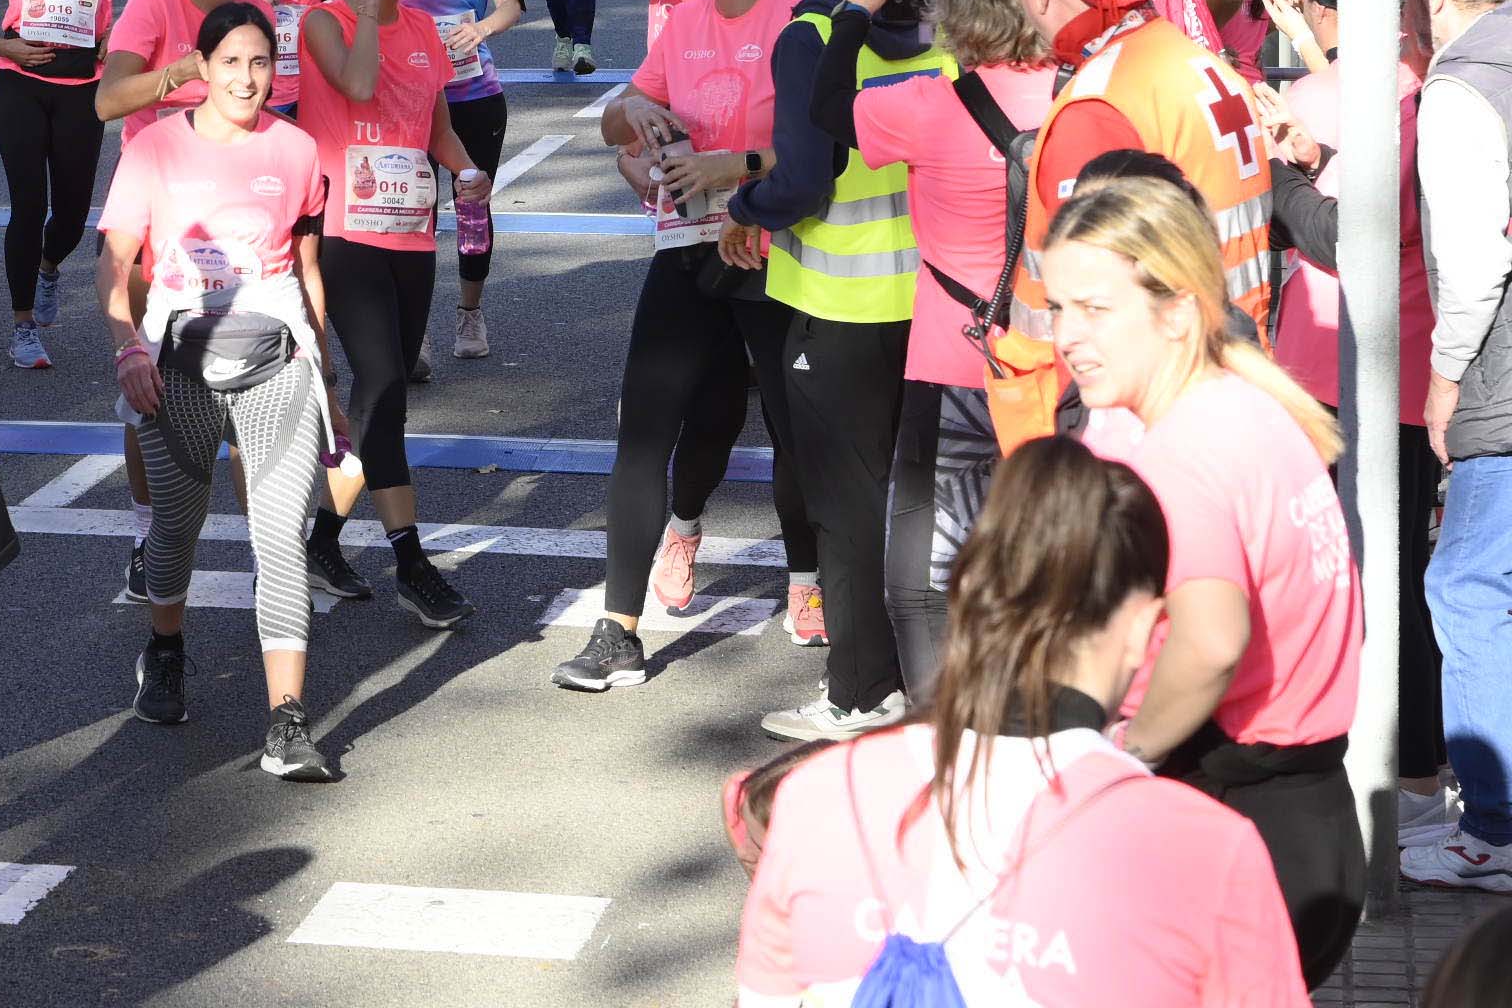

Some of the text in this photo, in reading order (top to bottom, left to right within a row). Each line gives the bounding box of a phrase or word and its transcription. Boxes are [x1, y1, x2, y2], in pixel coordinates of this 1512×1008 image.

[48, 4, 73, 15] 016
[275, 32, 292, 43] 16
[354, 120, 381, 143] TU
[379, 180, 409, 194] 016
[382, 196, 405, 206] 30042
[357, 206, 383, 214] CARRERA
[353, 218, 384, 227] OYSHO
[661, 231, 686, 242] OYSHO
